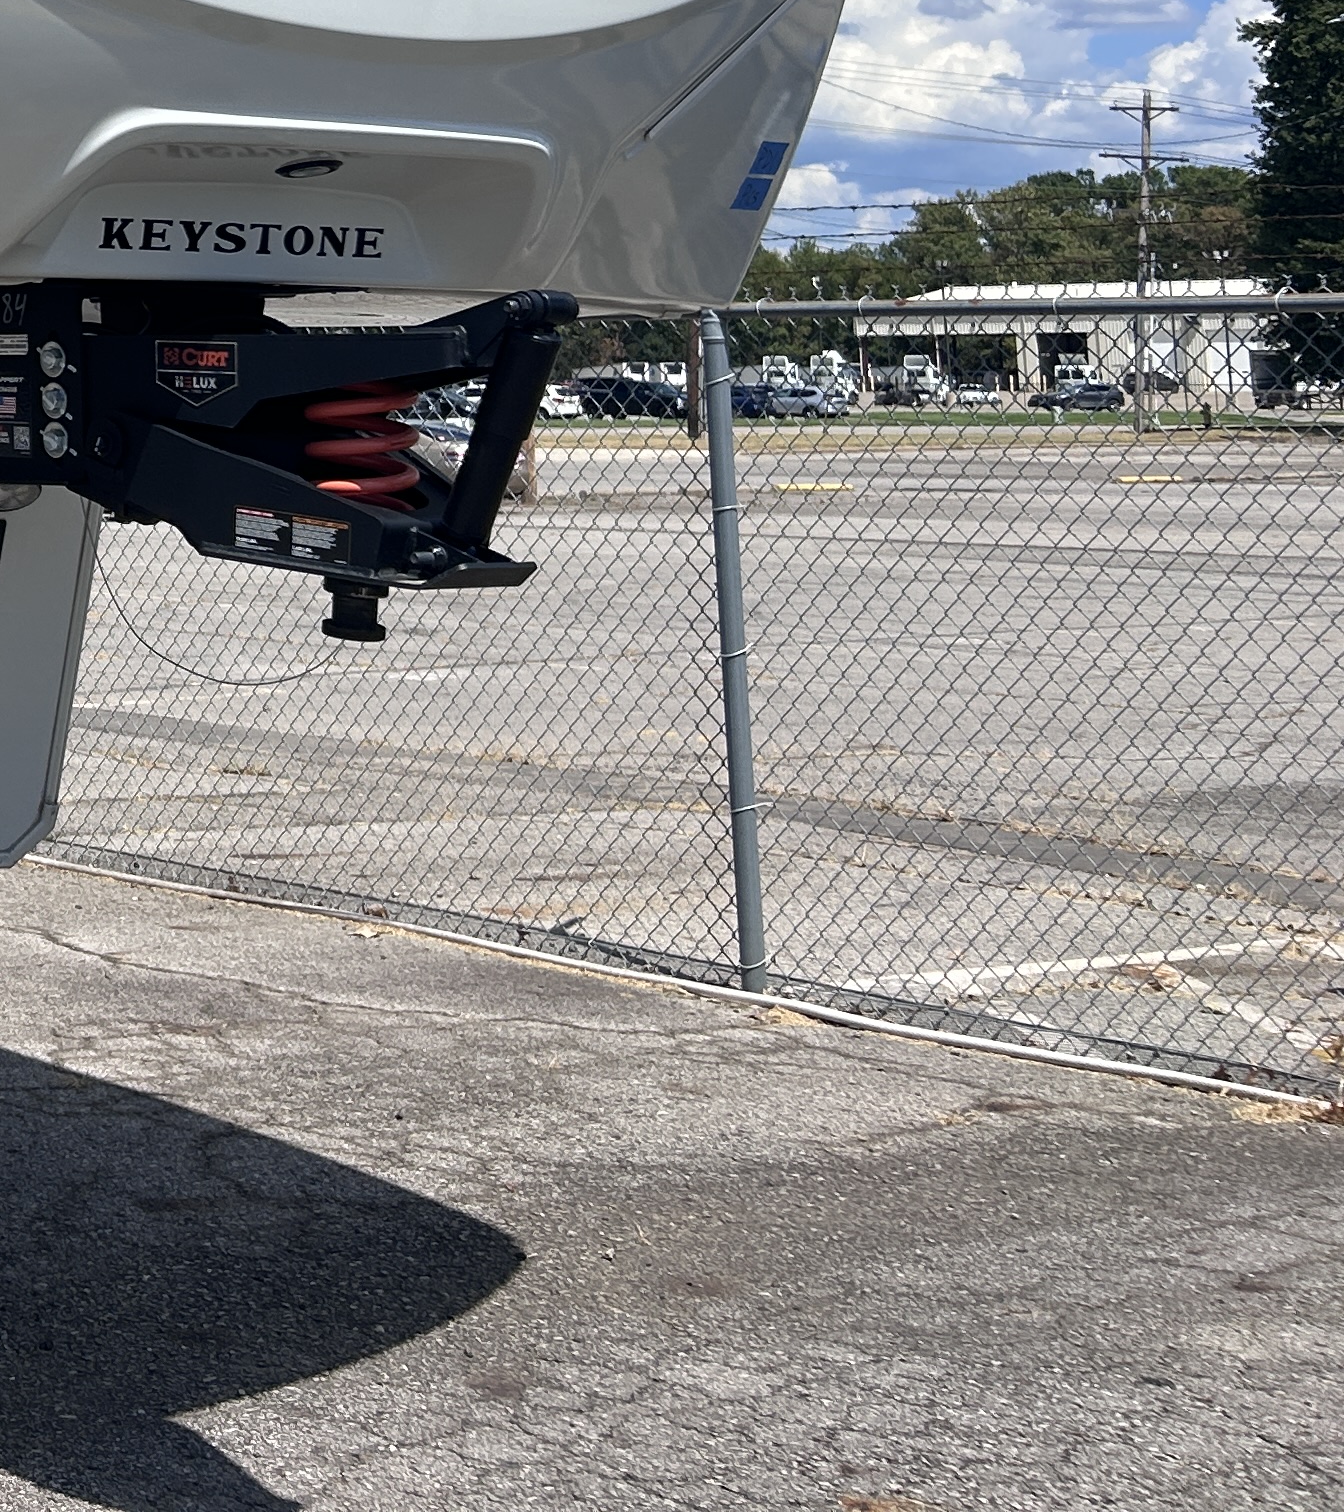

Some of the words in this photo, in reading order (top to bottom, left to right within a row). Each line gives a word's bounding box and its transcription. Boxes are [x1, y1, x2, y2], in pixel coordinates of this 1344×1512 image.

[98, 217, 385, 259] KEYSTONE
[182, 348, 229, 367] CURT
[175, 375, 218, 389] HELUX
